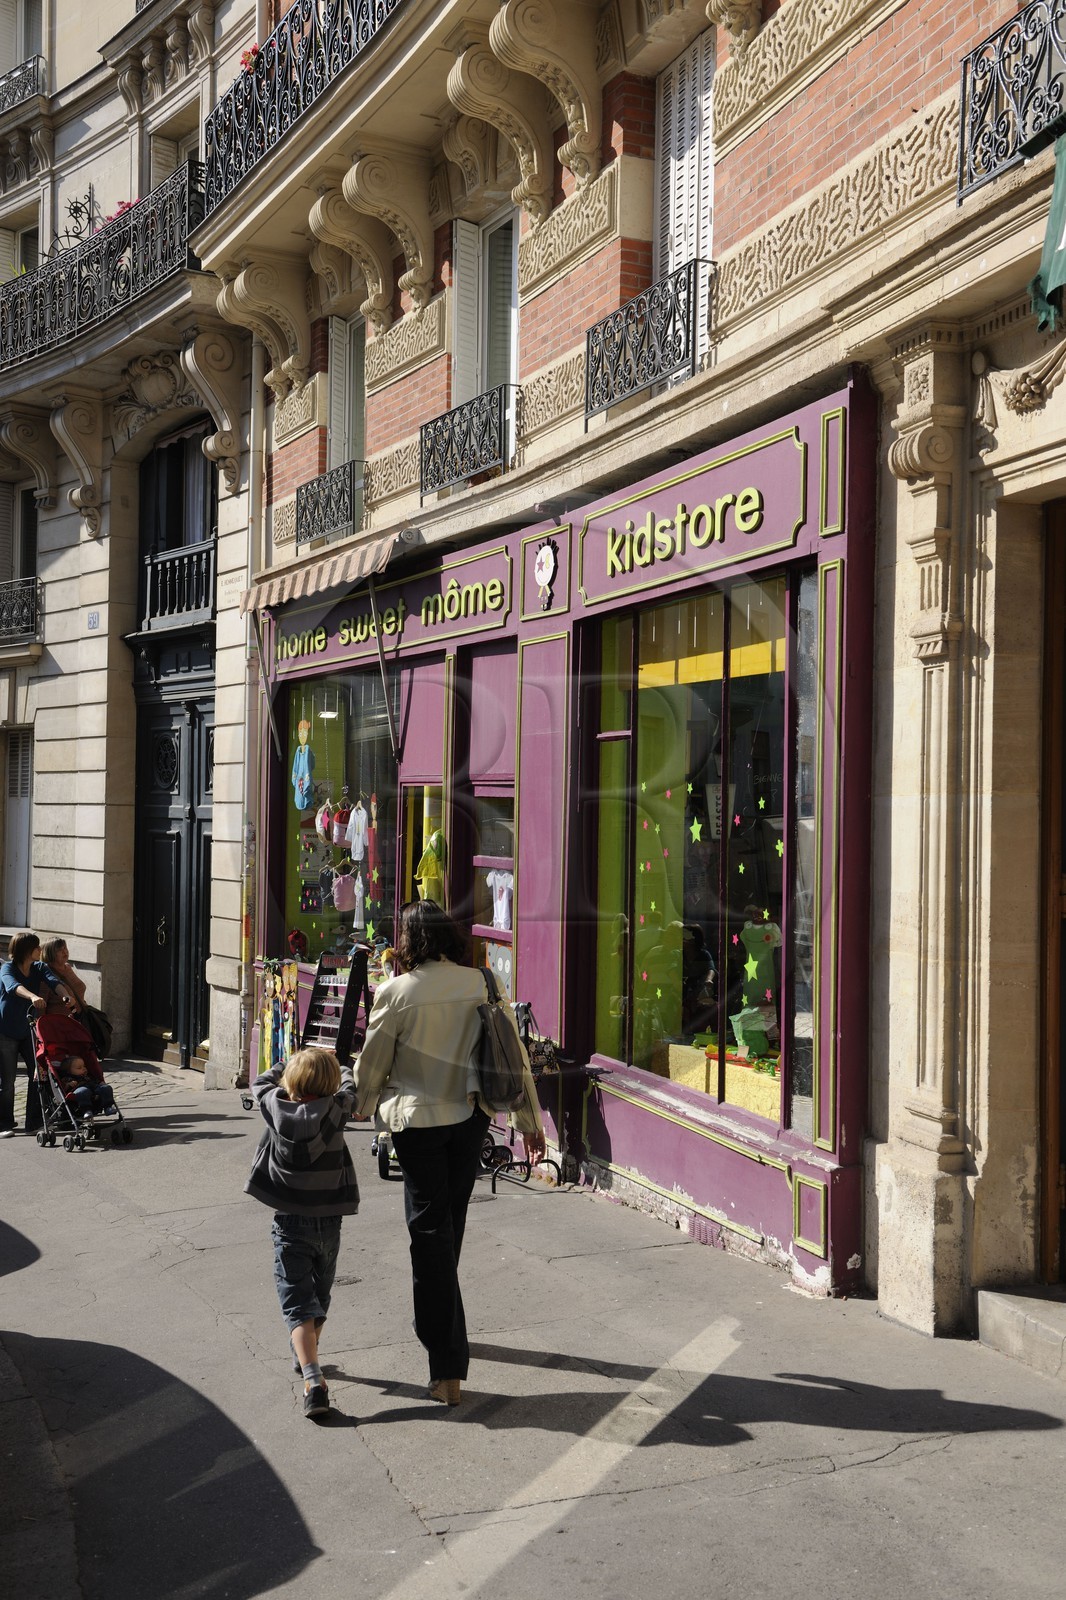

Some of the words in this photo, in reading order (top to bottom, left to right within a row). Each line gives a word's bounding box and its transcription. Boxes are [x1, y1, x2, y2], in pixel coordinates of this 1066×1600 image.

[606, 487, 764, 578] kidstore
[277, 625, 327, 659] home
[338, 599, 406, 645] sweet
[421, 578, 505, 626] môme
